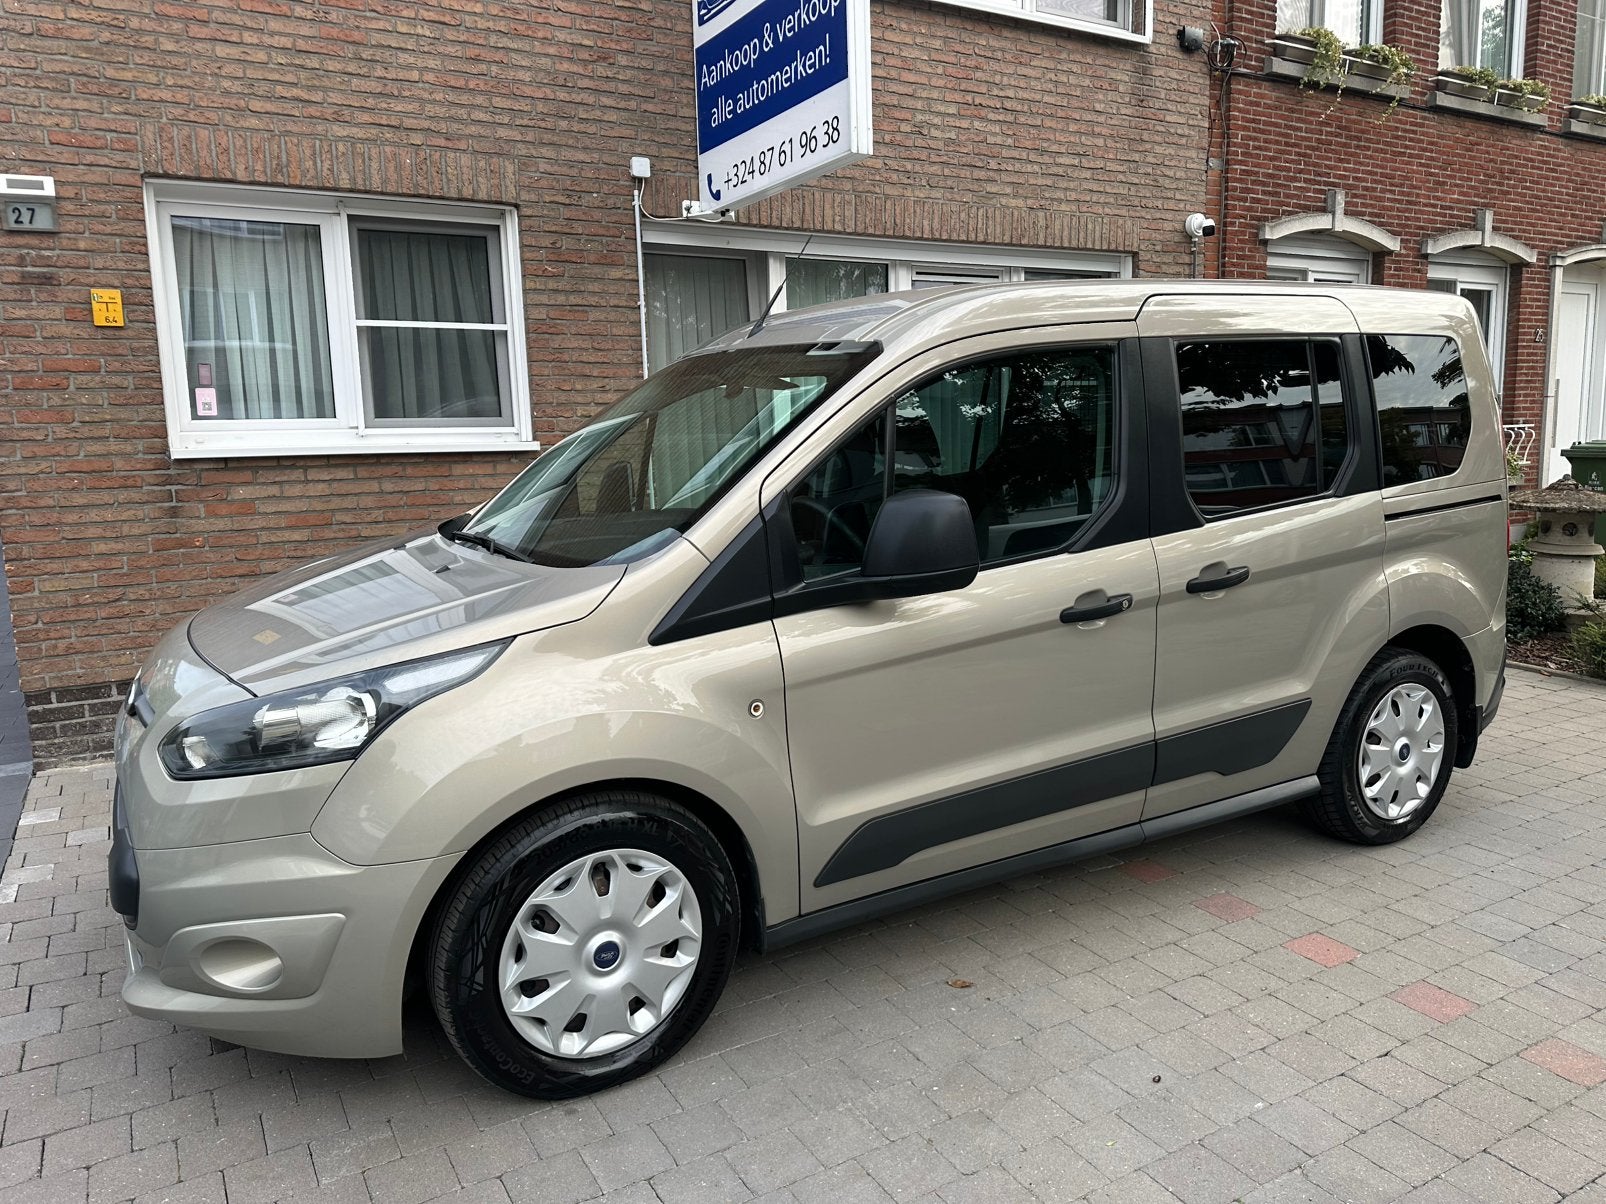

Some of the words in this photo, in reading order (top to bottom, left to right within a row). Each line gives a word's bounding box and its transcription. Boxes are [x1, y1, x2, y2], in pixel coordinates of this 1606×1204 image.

[700, 38, 759, 91] Aankoop
[763, 23, 774, 52] &
[776, 0, 841, 43] verkoop
[711, 97, 733, 127] alle
[737, 33, 830, 114] automerken!
[724, 156, 754, 190] +324
[758, 147, 775, 176] 87
[778, 137, 794, 167] 61
[799, 126, 818, 158] 96
[822, 115, 840, 148] 38
[12, 206, 35, 225] 27
